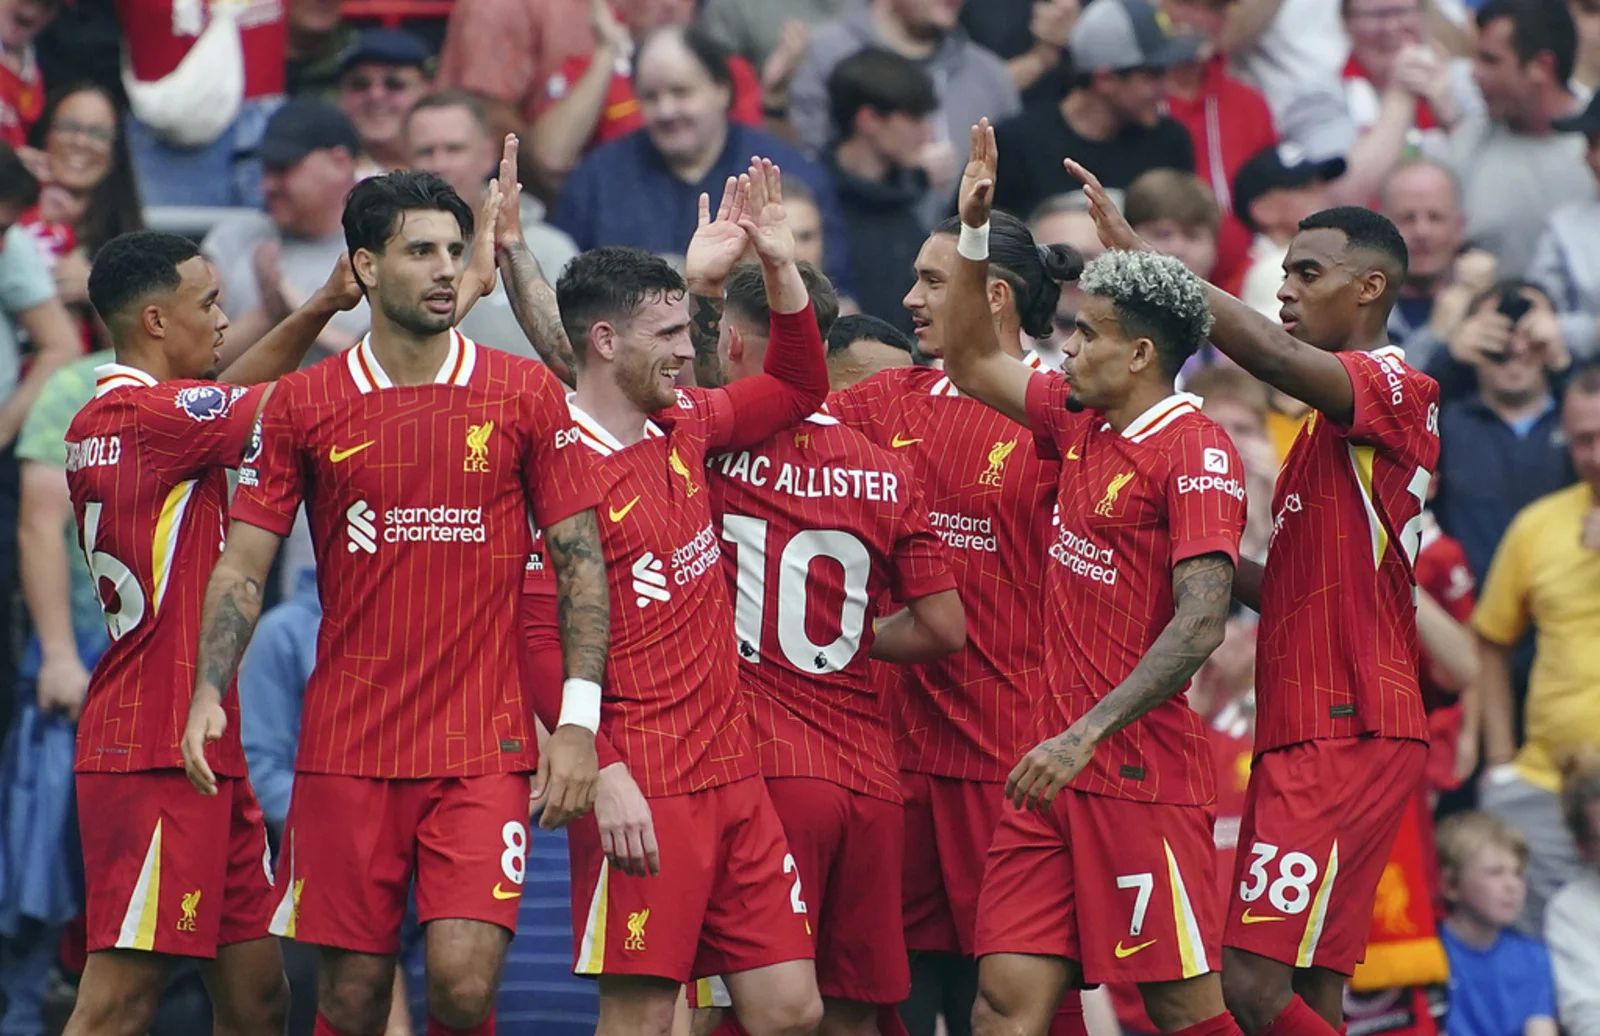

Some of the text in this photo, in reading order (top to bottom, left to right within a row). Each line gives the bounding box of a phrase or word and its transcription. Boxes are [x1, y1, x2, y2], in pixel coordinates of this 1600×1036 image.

[774, 463, 898, 504] ALLISTER
[383, 524, 486, 543] chartered
[384, 505, 482, 525] standard
[722, 513, 871, 674] 10
[501, 820, 527, 885] 8
[783, 853, 808, 914] 2
[1240, 842, 1318, 914] 38
[1116, 872, 1154, 936] 7
